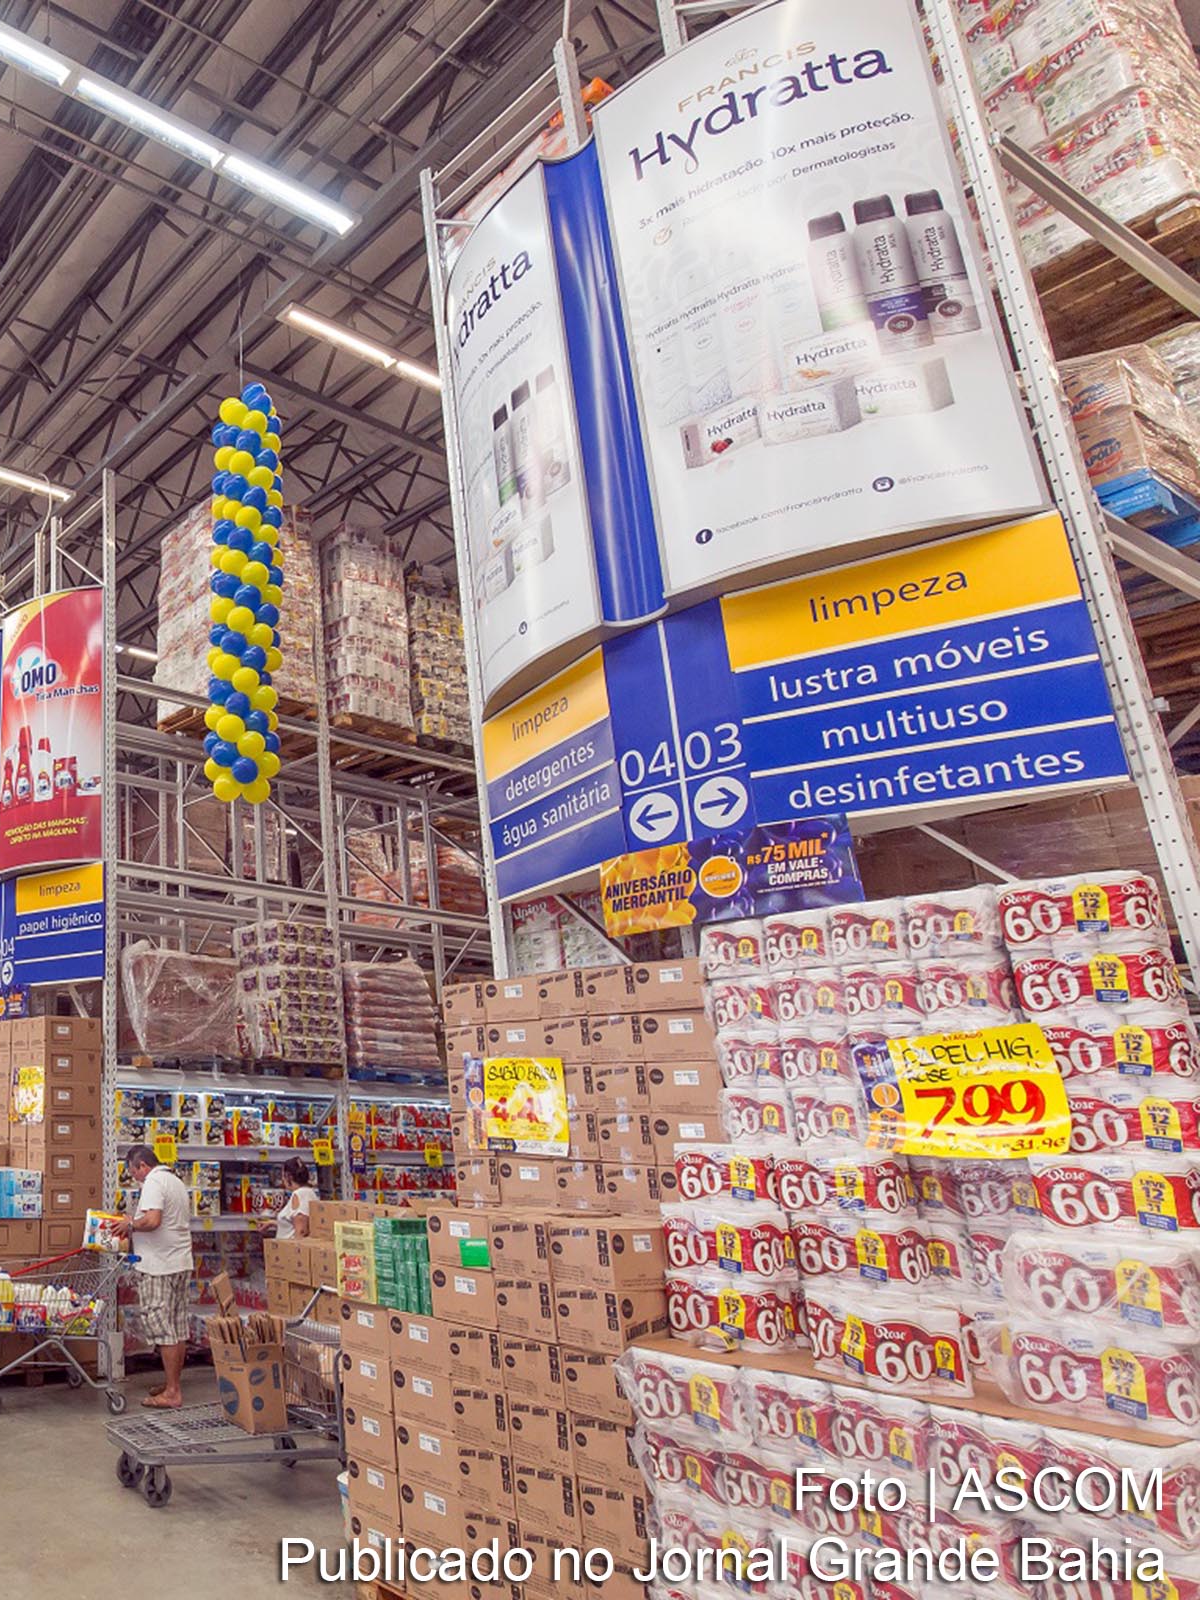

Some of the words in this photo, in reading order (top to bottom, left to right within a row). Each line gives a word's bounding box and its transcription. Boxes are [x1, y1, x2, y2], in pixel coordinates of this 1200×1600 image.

[676, 41, 817, 113] FRANCIS
[628, 48, 893, 181] Hydratta
[655, 194, 687, 221] mais
[771, 144, 798, 162] 10x
[799, 130, 838, 151] mais
[839, 112, 916, 142] proteção.
[791, 141, 897, 179] Dermatologistas
[796, 338, 868, 367] Hydratta
[706, 406, 759, 438] Hydratta
[767, 400, 827, 423] Hydratta
[809, 569, 968, 624] limpeza
[20, 663, 58, 693] OMO
[769, 662, 878, 702] lustra
[893, 625, 1050, 678] móveis
[53, 684, 99, 698] Manchas
[511, 695, 569, 742] limpeza
[821, 699, 1009, 750] multiuso
[620, 741, 676, 787] 04
[684, 722, 742, 770] 03
[505, 739, 595, 802] detergentes
[788, 748, 1086, 810] desinfetantes
[502, 818, 538, 848] água
[542, 781, 611, 826] sanitária
[605, 867, 692, 899] ANIVERSÁRIO
[767, 860, 786, 874] EM
[768, 867, 828, 887] COMPRAS
[39, 880, 81, 897] limpeza
[611, 886, 689, 913] MERCANTIL
[1081, 898, 1100, 909] 12
[19, 915, 49, 936] papel
[51, 910, 102, 932] higiênico
[830, 923, 867, 956] 60
[1004, 899, 1062, 943] 60
[1022, 968, 1081, 1012] 60
[1099, 967, 1119, 978] 12
[781, 1046, 818, 1081] 60
[1122, 1040, 1142, 1051] 12
[1148, 1112, 1170, 1125] 12
[680, 1162, 723, 1199] 60
[779, 1170, 827, 1210] 60
[842, 1176, 857, 1186] 12
[1049, 1169, 1086, 1182] Rose
[1142, 1187, 1164, 1199] 12
[1050, 1180, 1121, 1228] 60
[668, 1231, 709, 1267] 60
[721, 1236, 735, 1247] 12
[752, 1237, 785, 1276] 60
[798, 1236, 848, 1275] 60
[900, 1244, 932, 1284] 60
[1030, 1266, 1101, 1313] 60
[668, 1293, 711, 1331] 60
[874, 1326, 907, 1341] Rose
[875, 1340, 933, 1383] 60
[1019, 1353, 1089, 1402] 60
[638, 1377, 682, 1418] 60
[832, 1415, 884, 1460] 60
[936, 1440, 992, 1489] 60
[722, 1466, 766, 1509] 60
